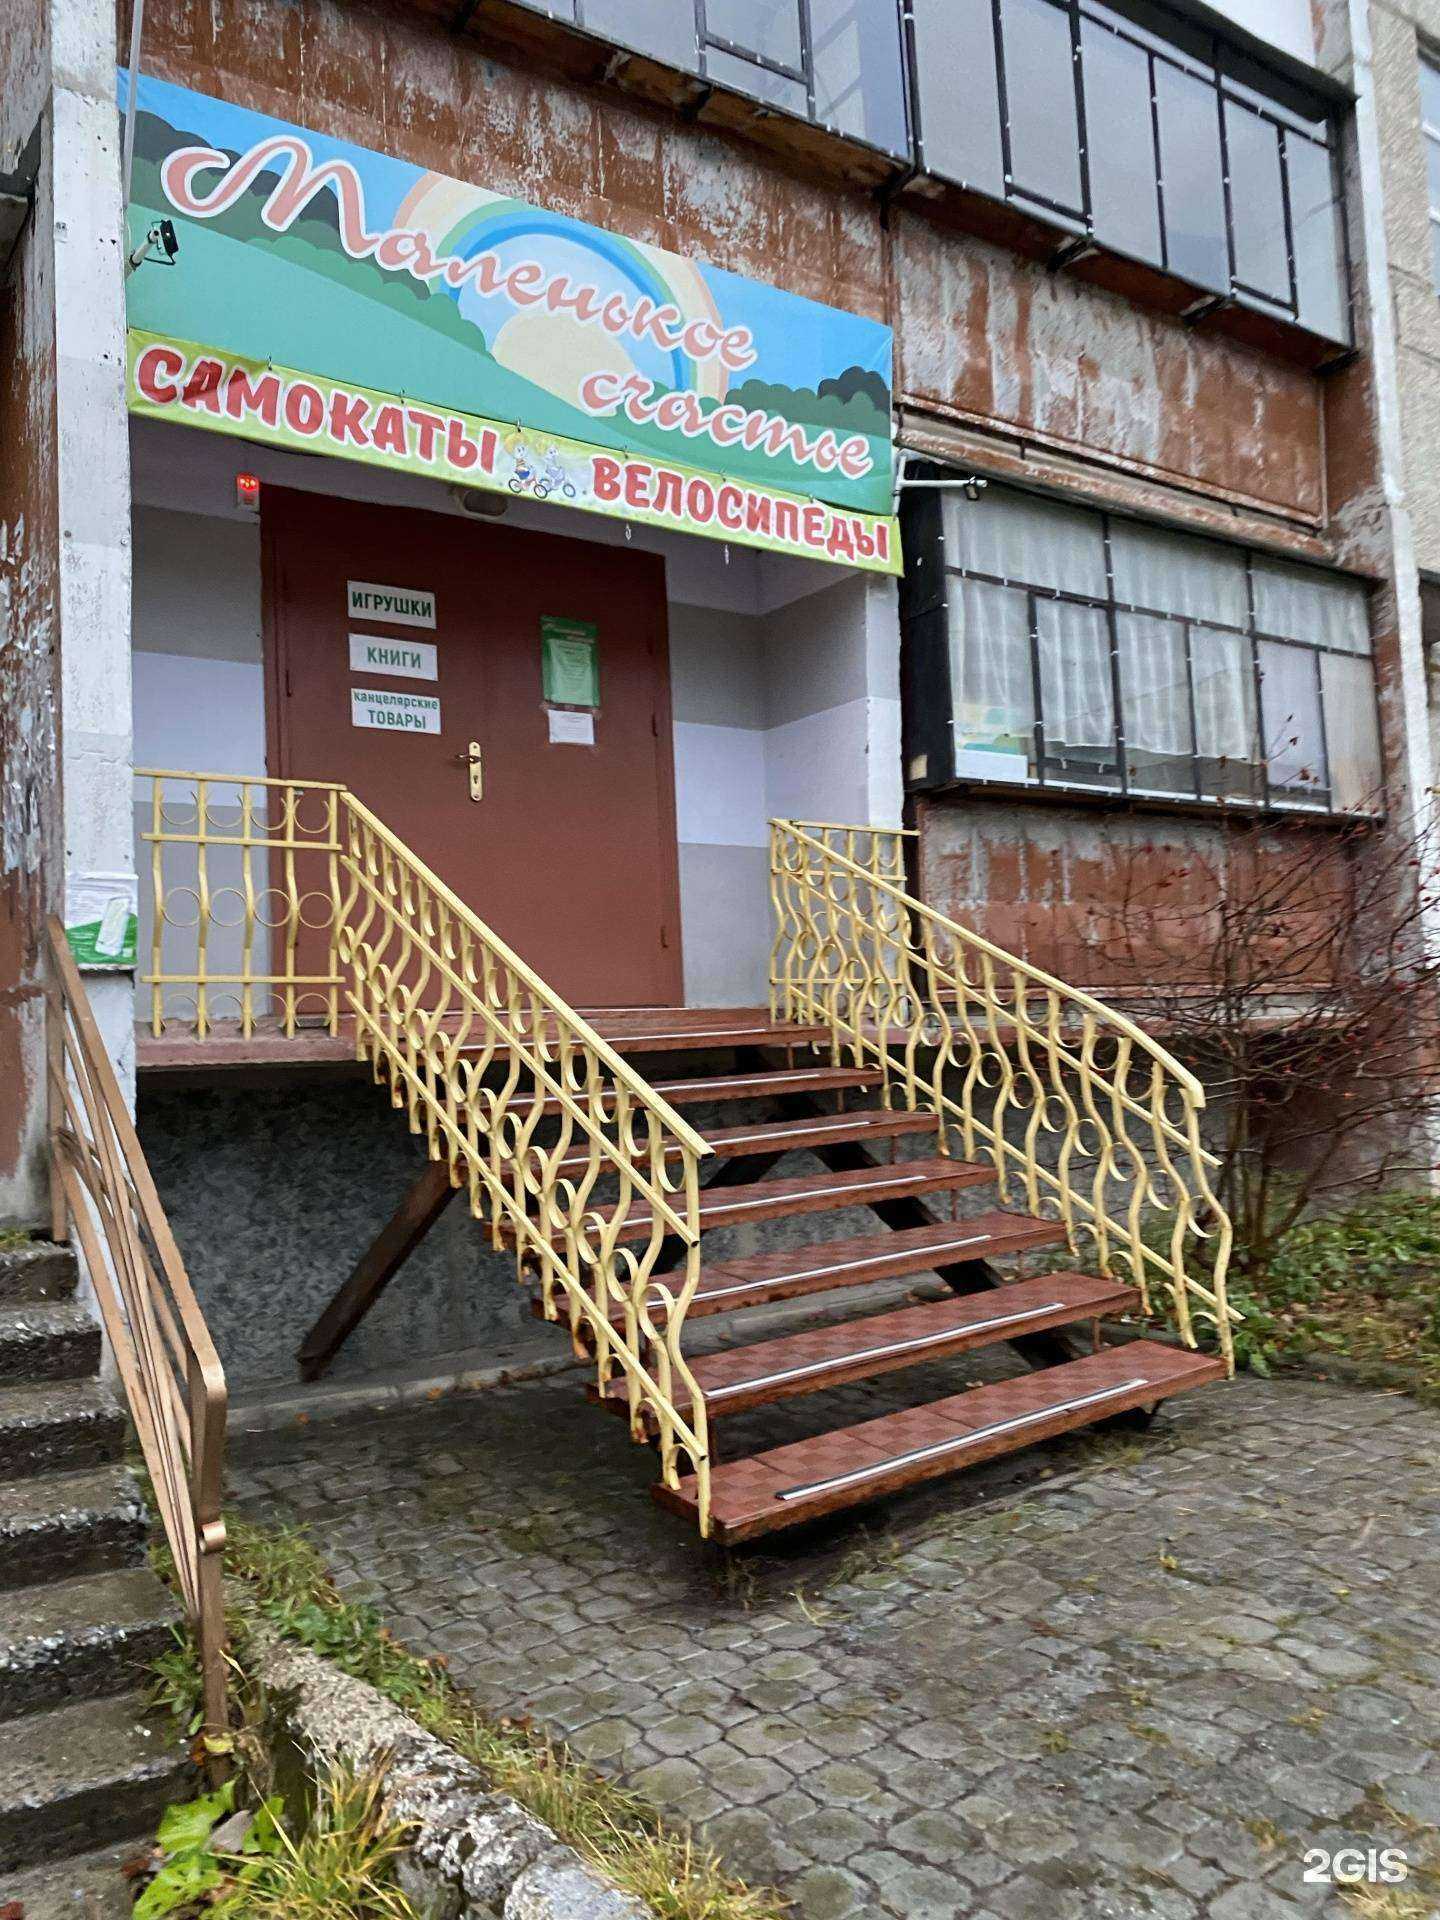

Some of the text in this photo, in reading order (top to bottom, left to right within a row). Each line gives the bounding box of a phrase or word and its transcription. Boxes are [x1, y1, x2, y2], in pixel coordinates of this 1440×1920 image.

[161, 136, 757, 371] Маленькое
[136, 346, 890, 563] САМОКАТЫ ВЕЛОСИПЕДЫ
[579, 365, 874, 480] счастье
[352, 591, 432, 618] ИГРУШКИ
[367, 646, 422, 669] КНИГИ
[368, 709, 426, 730] ТОВАРЫ
